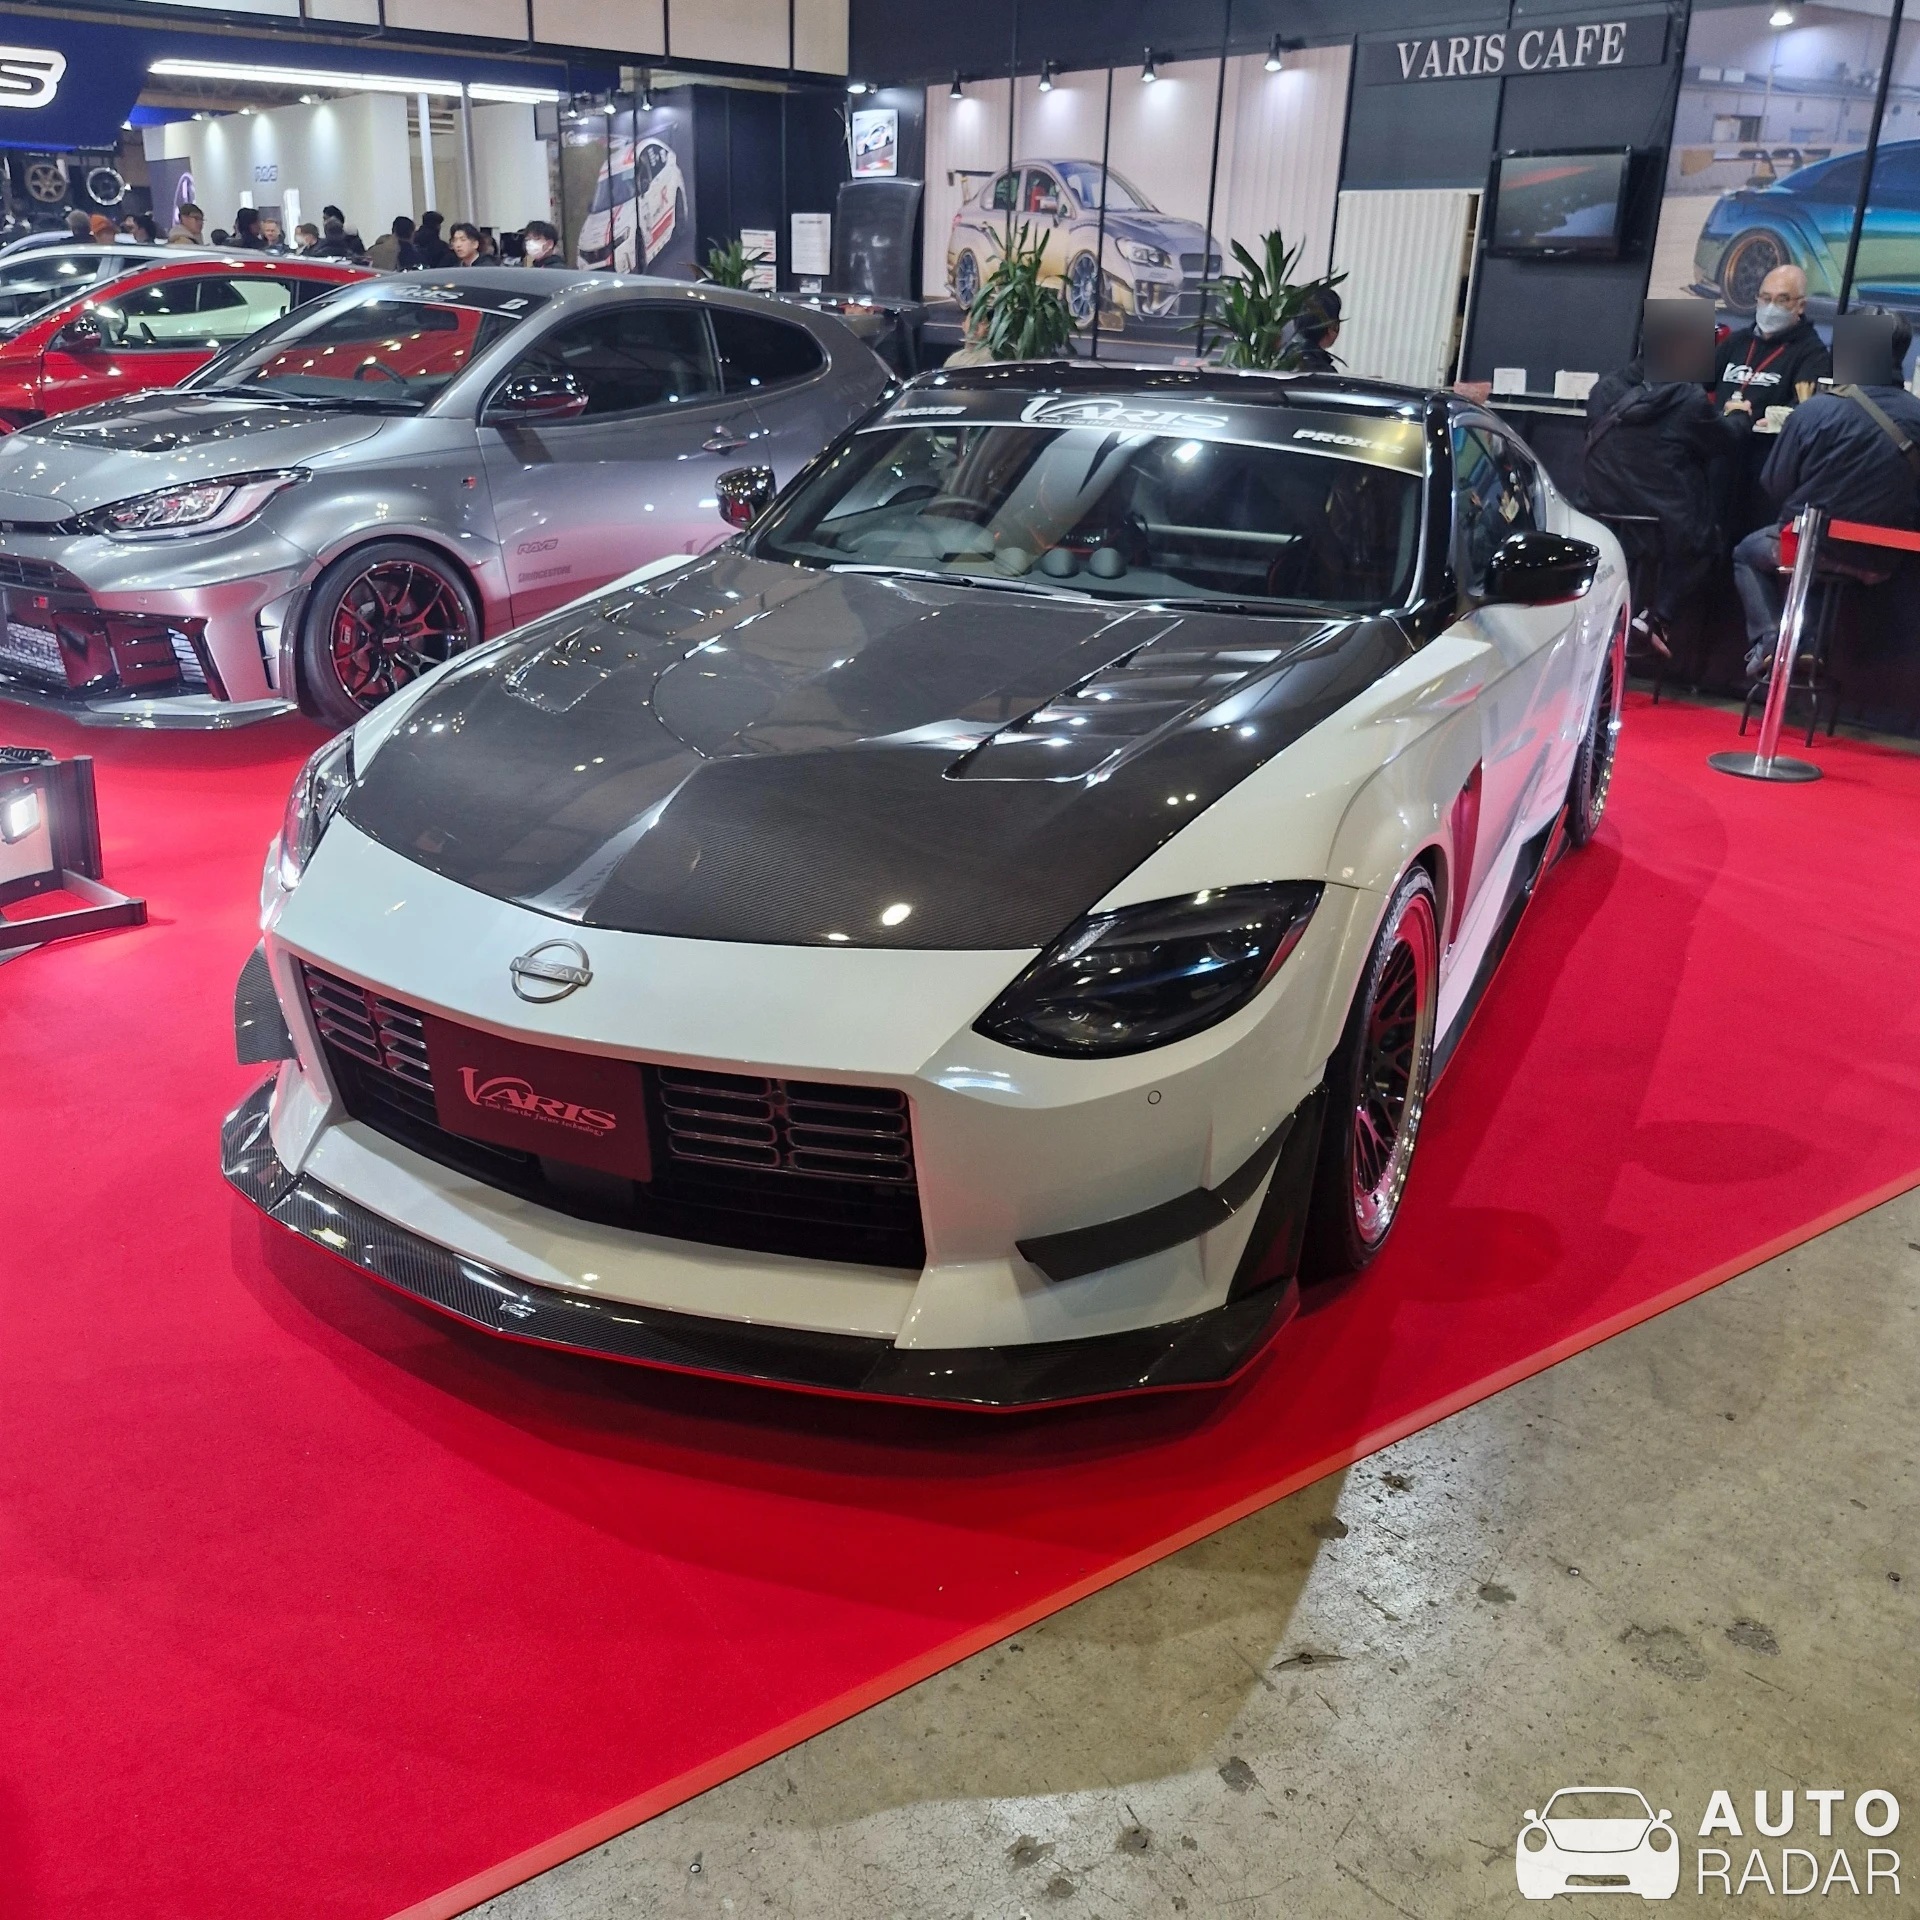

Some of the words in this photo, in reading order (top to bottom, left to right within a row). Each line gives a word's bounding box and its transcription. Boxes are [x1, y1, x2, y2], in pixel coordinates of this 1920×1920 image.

[1397, 33, 1507, 80] VARIS
[1518, 22, 1627, 71] CAFE
[1020, 396, 1229, 429] VARIS
[511, 957, 590, 984] NISSAN
[457, 1066, 617, 1130] VARIS
